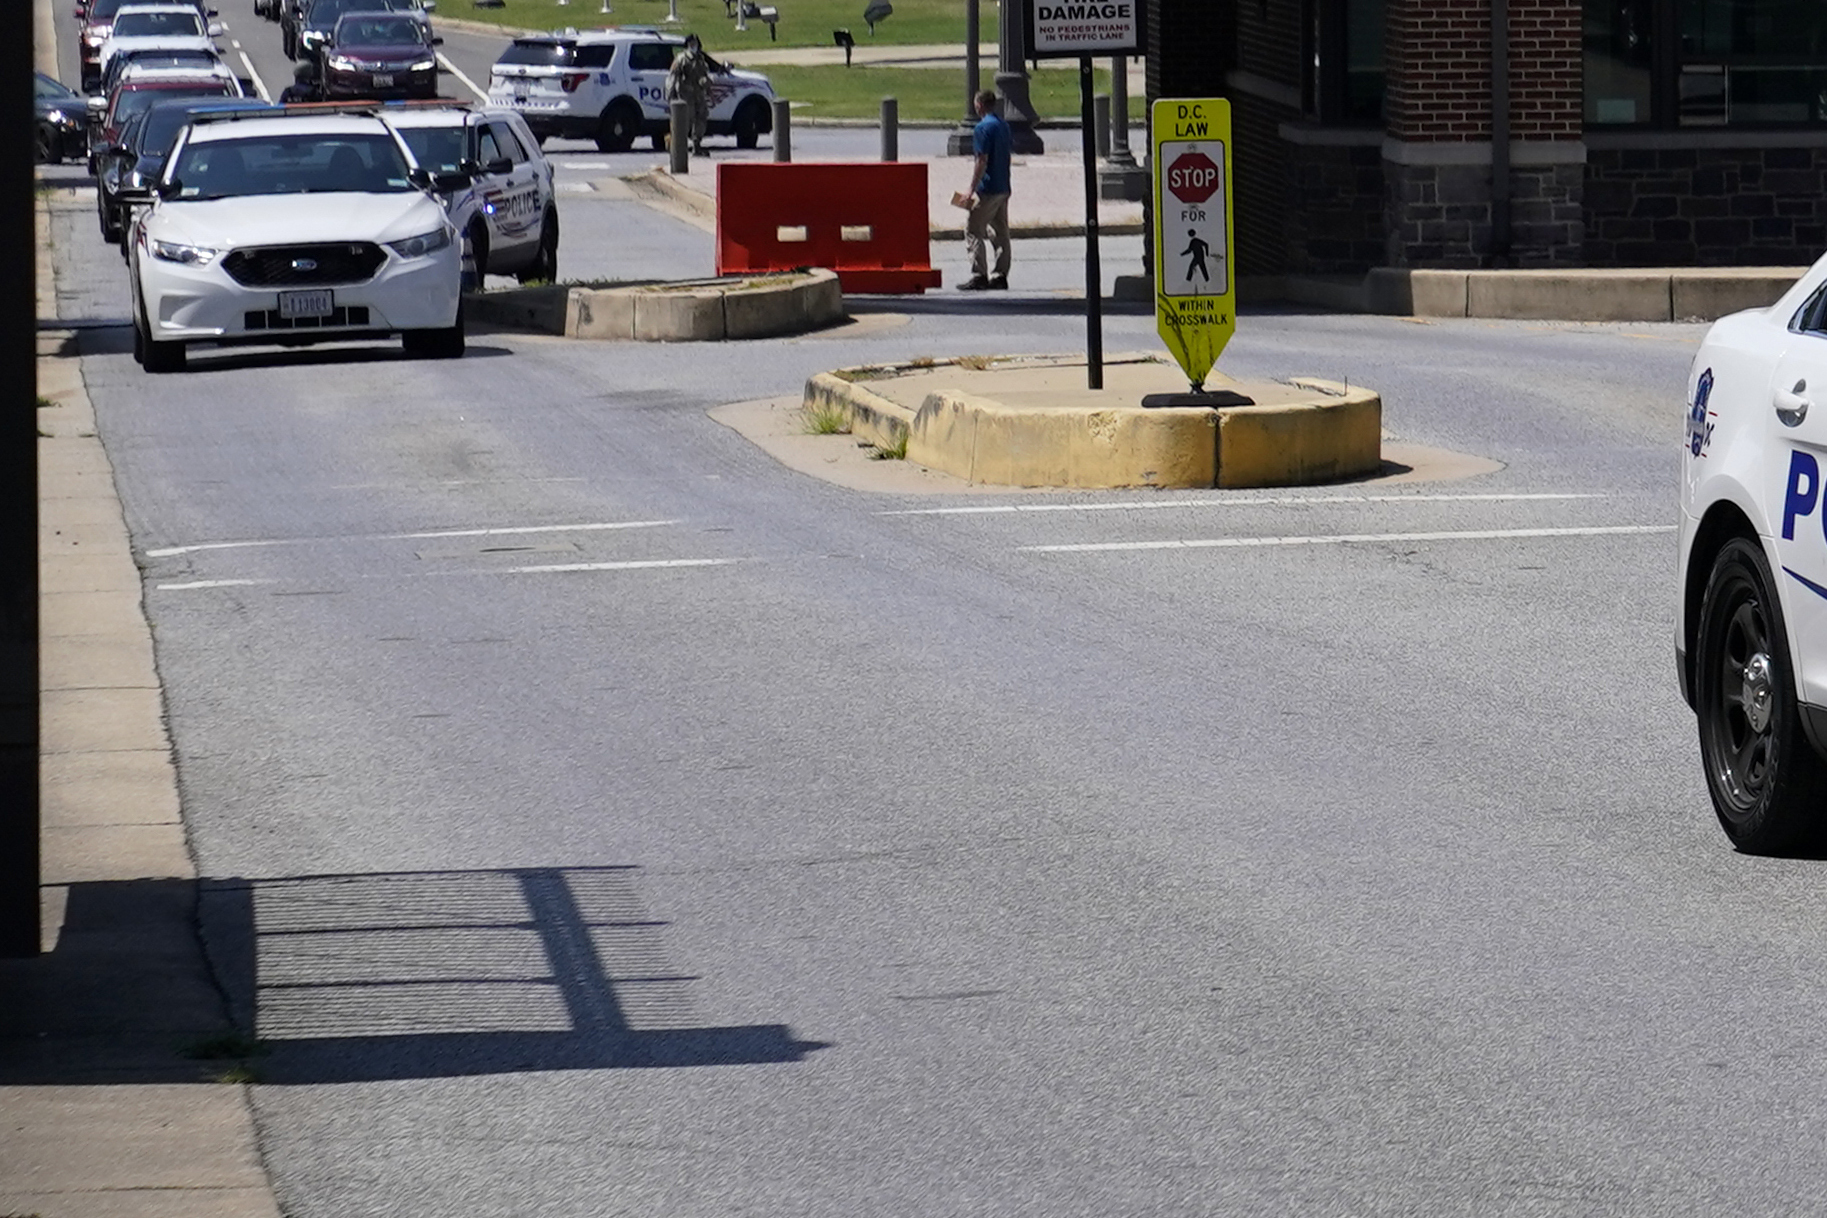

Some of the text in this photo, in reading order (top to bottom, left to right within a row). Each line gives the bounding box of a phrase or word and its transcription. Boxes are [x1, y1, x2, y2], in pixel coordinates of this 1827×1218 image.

[1038, 4, 1131, 21] DAMAGE
[1039, 24, 1130, 34] NO PEDESTRIANS
[1046, 31, 1125, 42] IN TRAFFIC LANE
[1177, 105, 1207, 120] D.C.
[1175, 122, 1209, 138] LAW
[1171, 168, 1217, 188] STOP
[504, 190, 541, 218] POLICE
[1181, 210, 1207, 222] FOR
[1177, 300, 1215, 312] WITHIN
[1165, 313, 1228, 327] CROSSWALK
